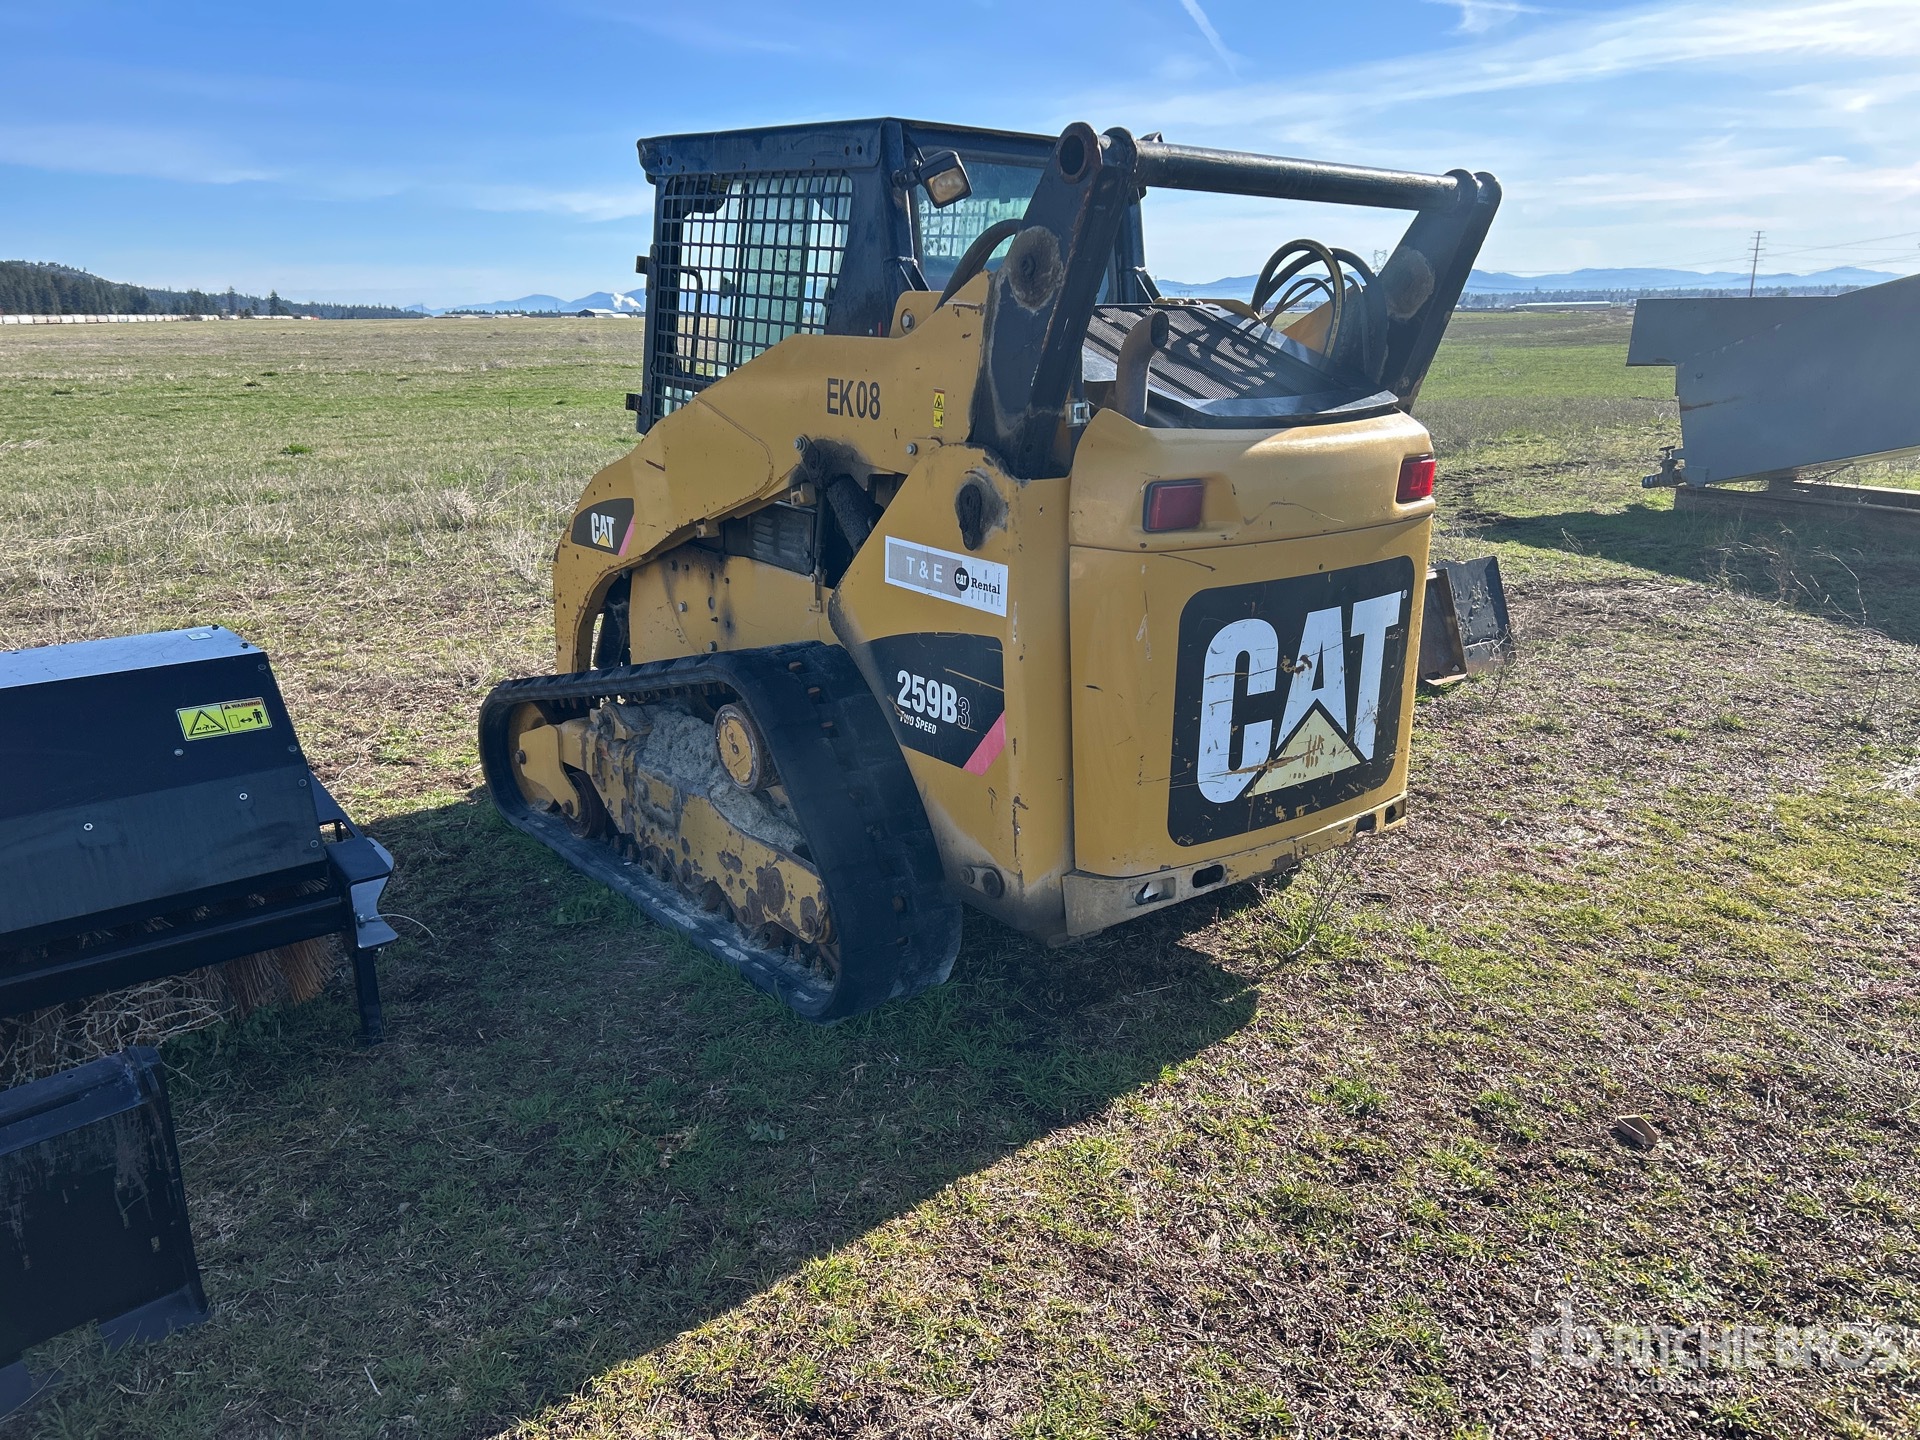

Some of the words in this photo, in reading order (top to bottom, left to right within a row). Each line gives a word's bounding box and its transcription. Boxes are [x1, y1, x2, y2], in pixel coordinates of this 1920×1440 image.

[826, 377, 881, 420] EK08
[591, 512, 615, 549] CAT
[906, 555, 916, 575] T
[919, 560, 929, 580] &
[933, 563, 943, 583] E
[955, 573, 968, 586] CAT
[970, 577, 1001, 595] Rental
[231, 700, 261, 709] WARNING
[1197, 590, 1402, 804] CAT
